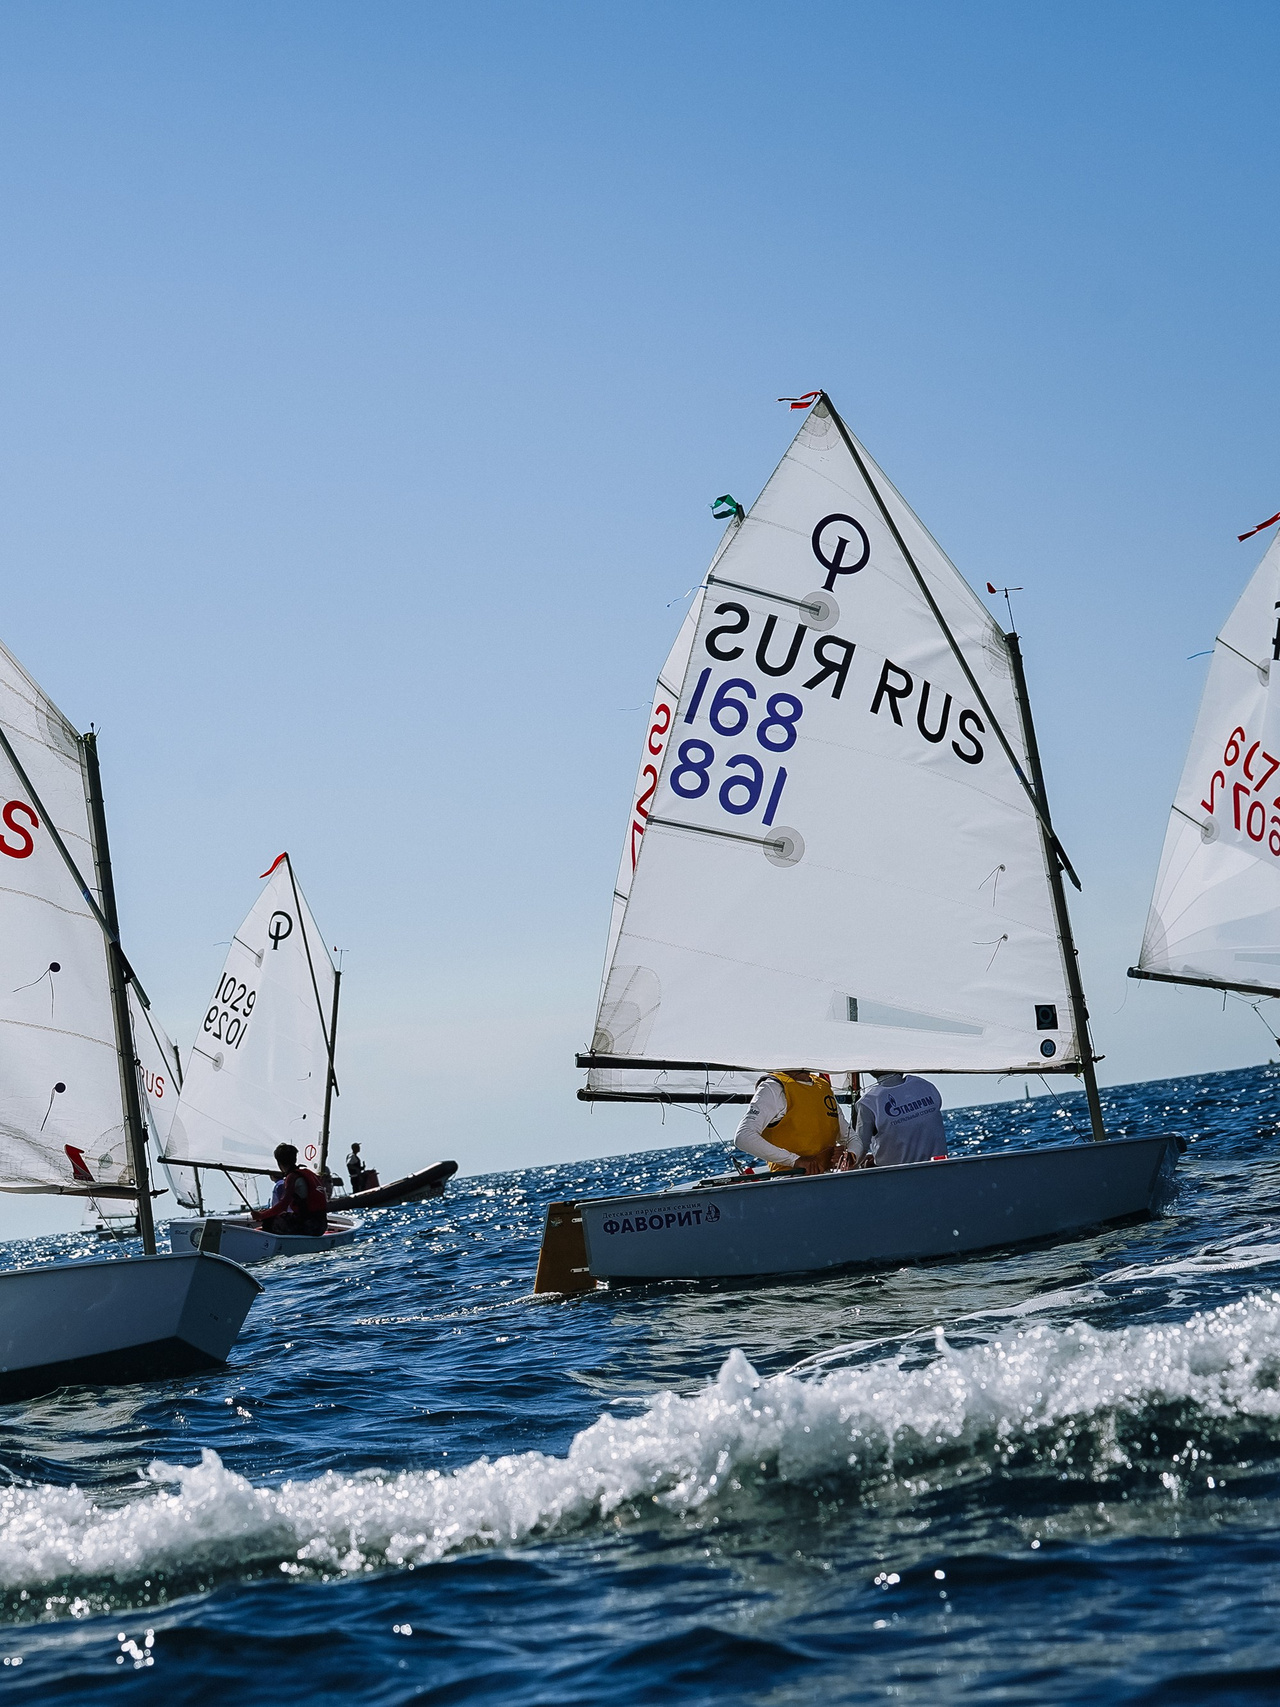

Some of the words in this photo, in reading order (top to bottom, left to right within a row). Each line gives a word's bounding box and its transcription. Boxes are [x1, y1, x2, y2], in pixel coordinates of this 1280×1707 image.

[683, 666, 805, 753] 168
[870, 658, 987, 765] RUS
[215, 972, 257, 1018] 1029
[900, 1096, 935, 1115] ГАЗПРОМ
[602, 1211, 633, 1220] Детская
[635, 1206, 671, 1215] парусная
[673, 1203, 702, 1211] секция
[603, 1210, 703, 1234] ФАВОРИТ
